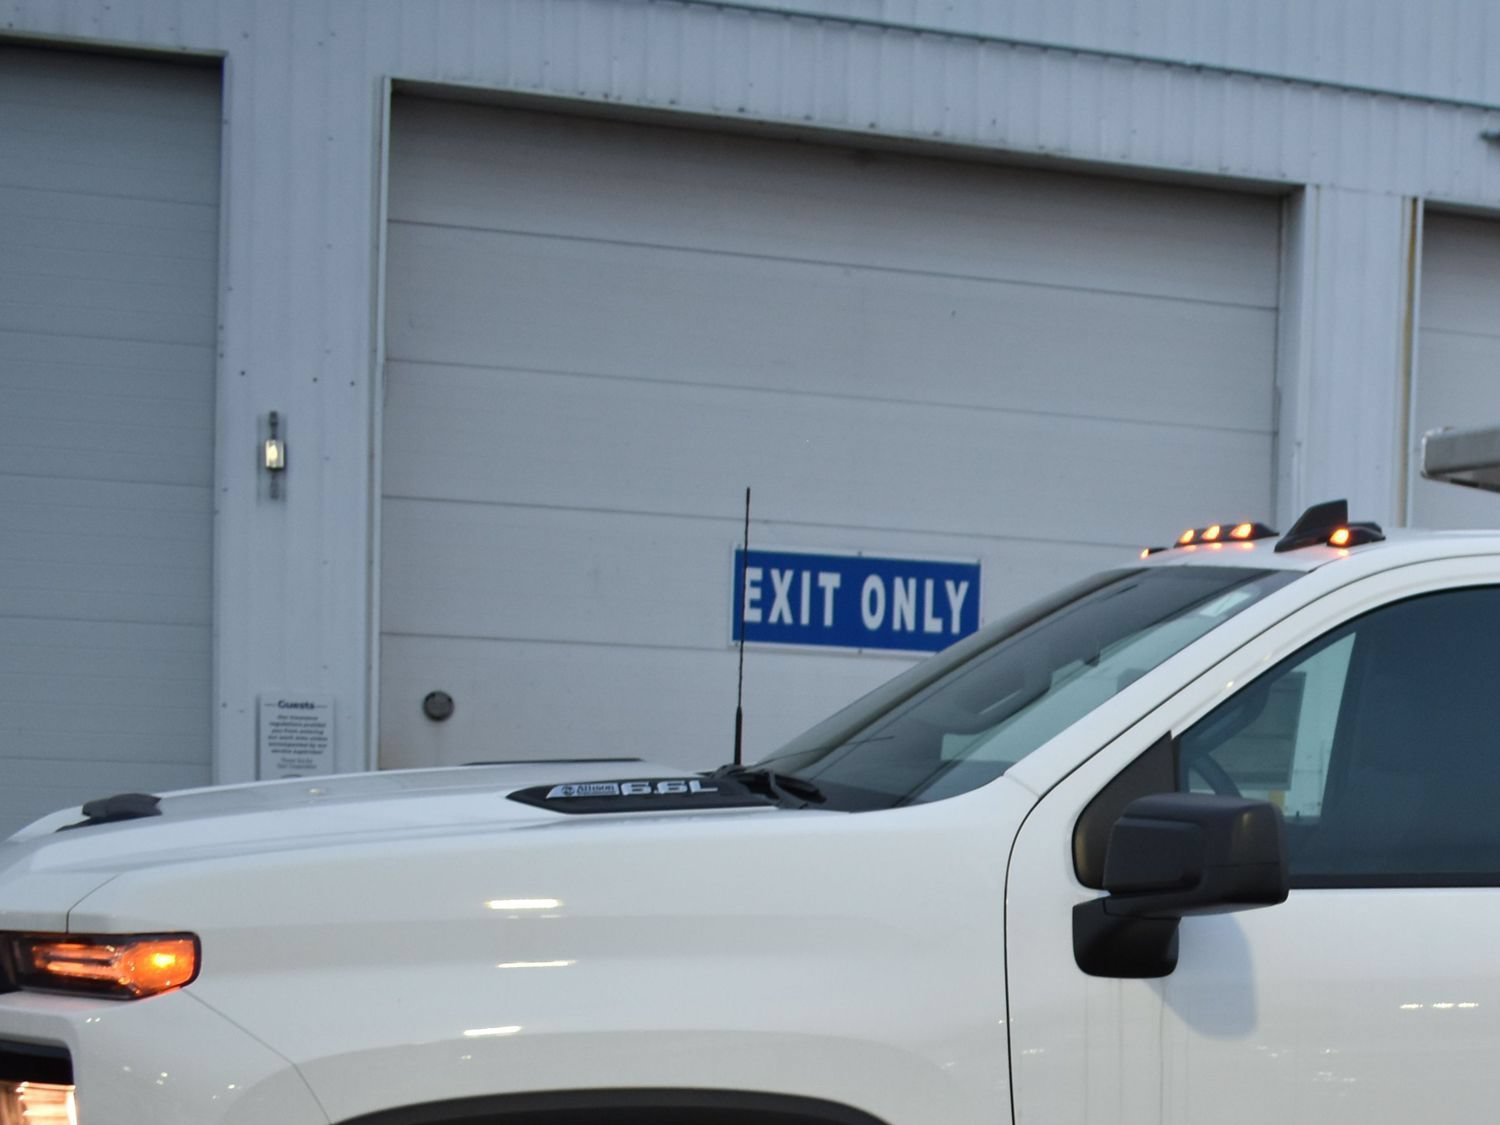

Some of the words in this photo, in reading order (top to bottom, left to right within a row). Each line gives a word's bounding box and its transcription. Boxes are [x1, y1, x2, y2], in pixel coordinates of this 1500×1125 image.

[743, 566, 841, 627] EXIT
[861, 574, 969, 634] ONLY
[277, 700, 315, 710] Guests
[621, 780, 718, 796] 6.6L
